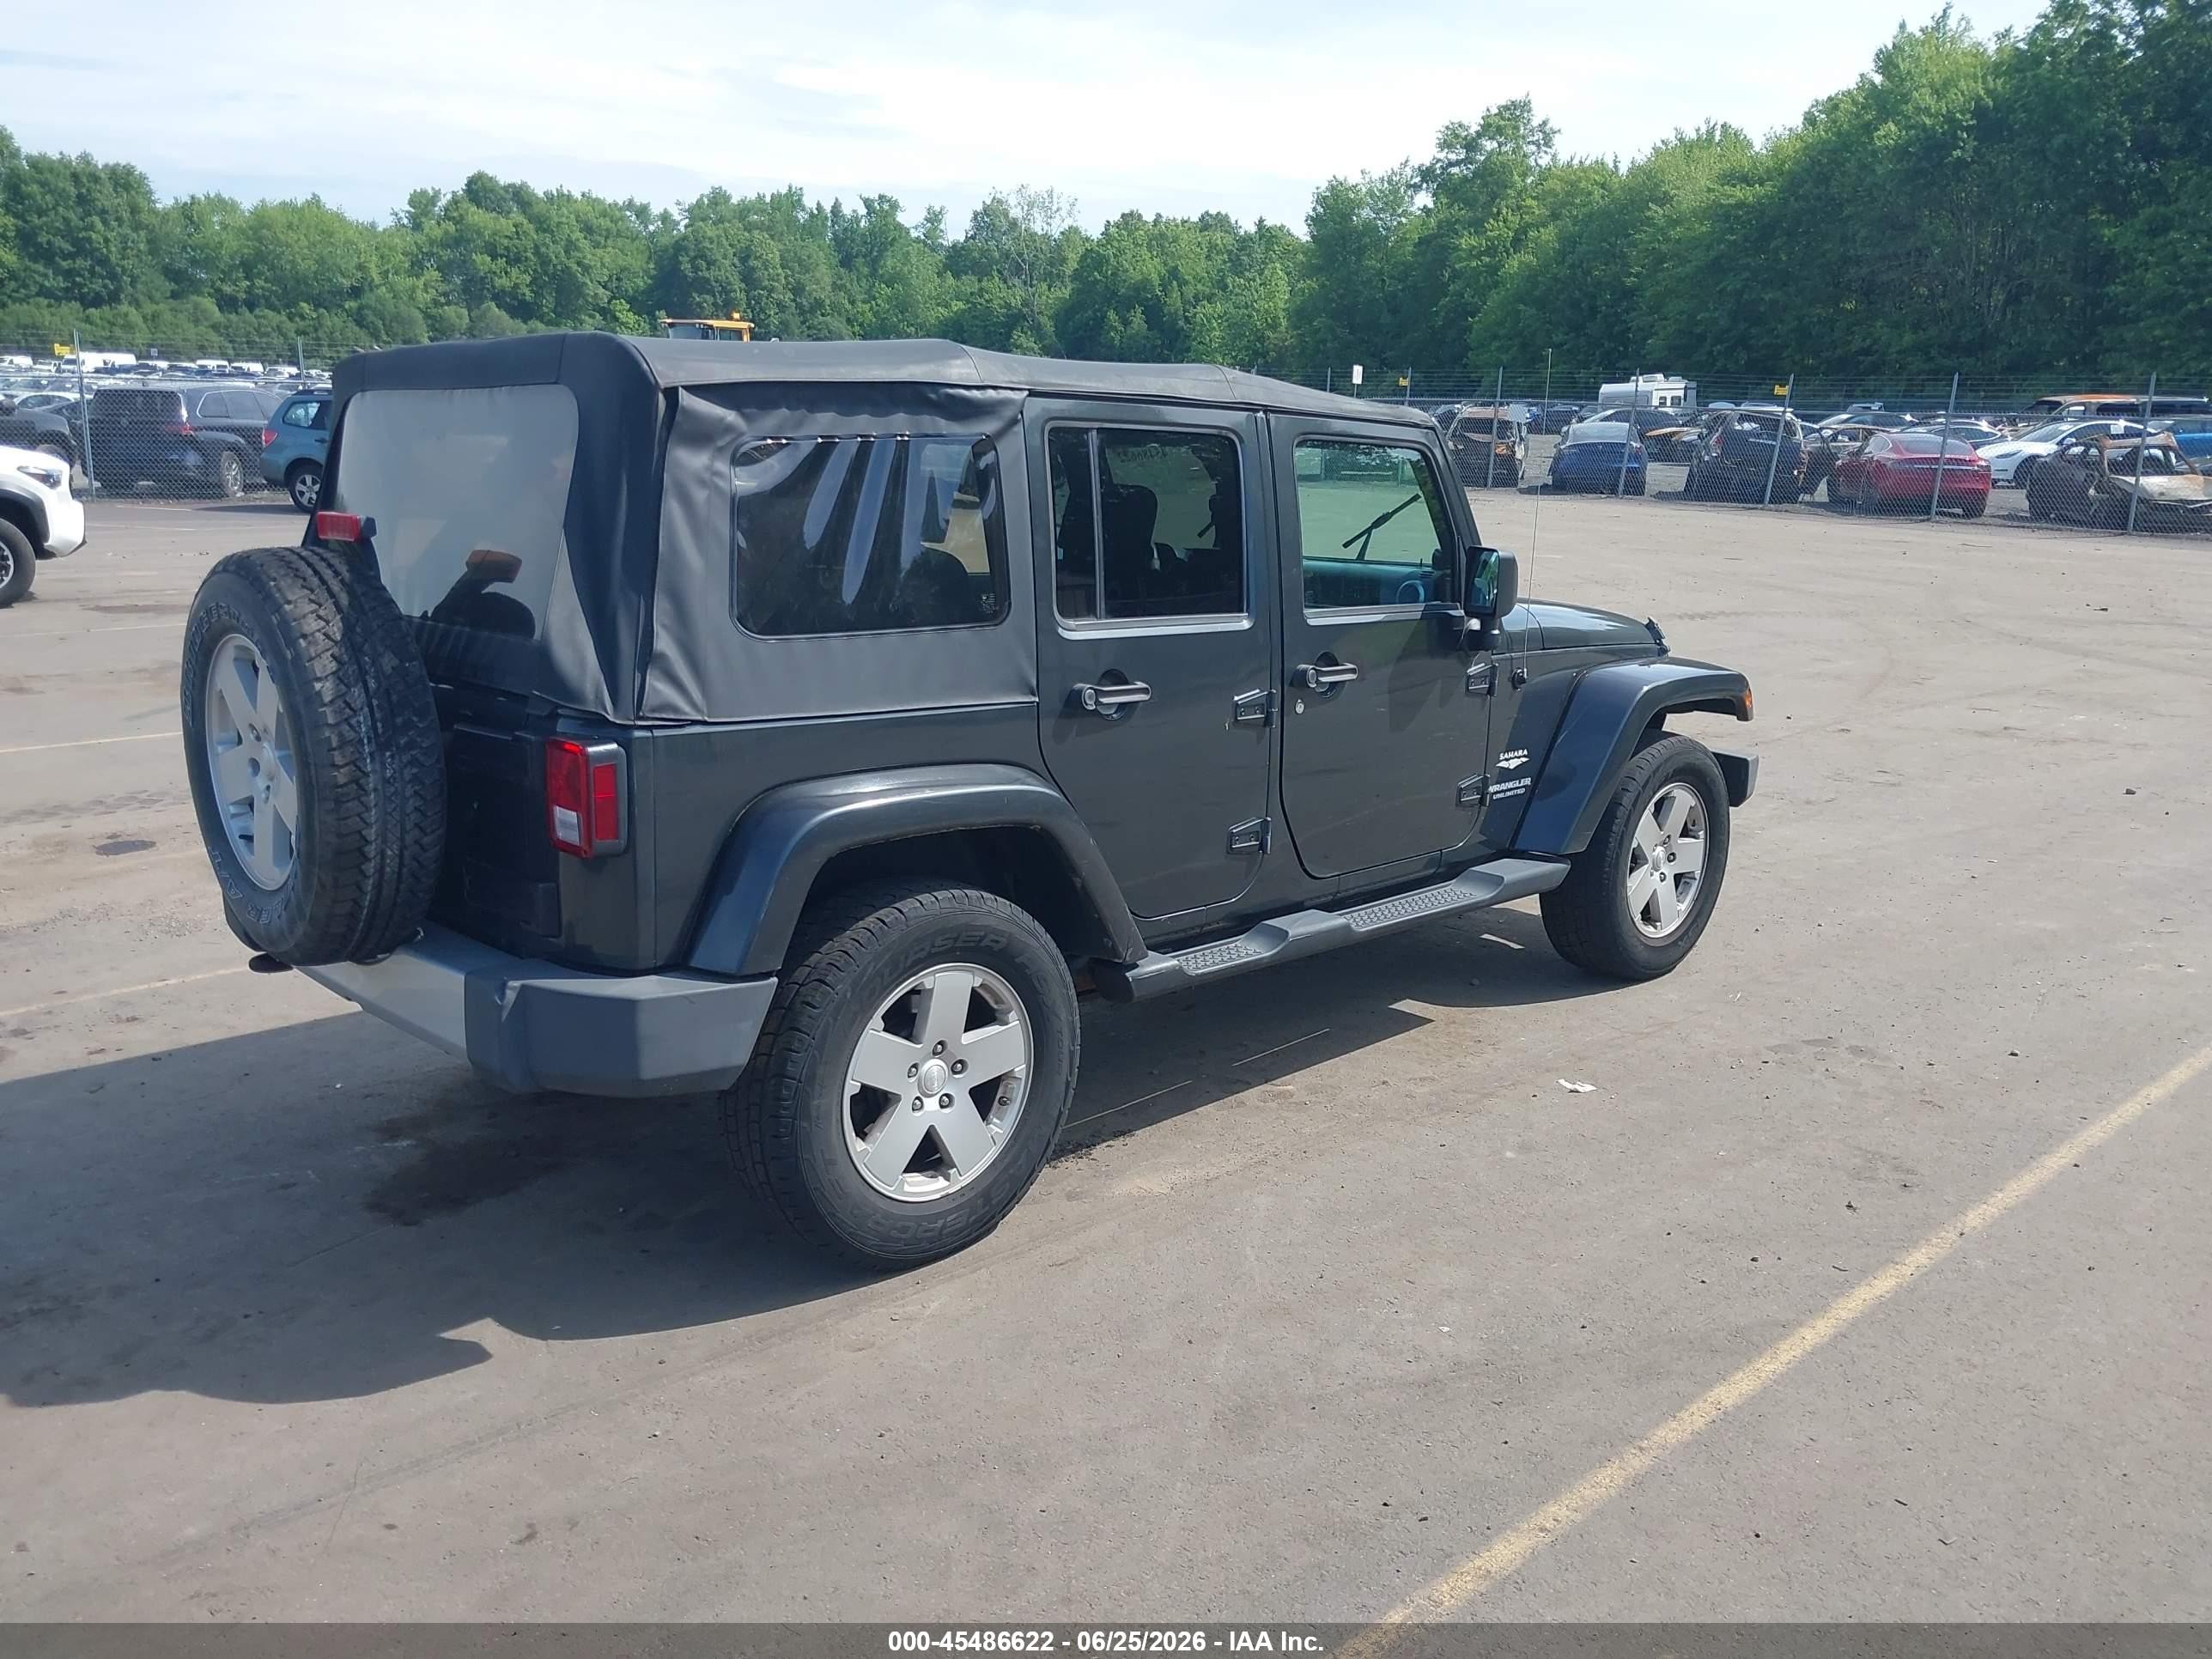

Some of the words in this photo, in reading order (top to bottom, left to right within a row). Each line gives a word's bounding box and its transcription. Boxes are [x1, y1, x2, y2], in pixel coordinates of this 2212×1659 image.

[1499, 749, 1528, 760] SAHARA
[1488, 777, 1532, 793] WRANGLER
[1492, 788, 1525, 799] UNLIMITED
[818, 1130, 1042, 1239] ASTERCRFT
